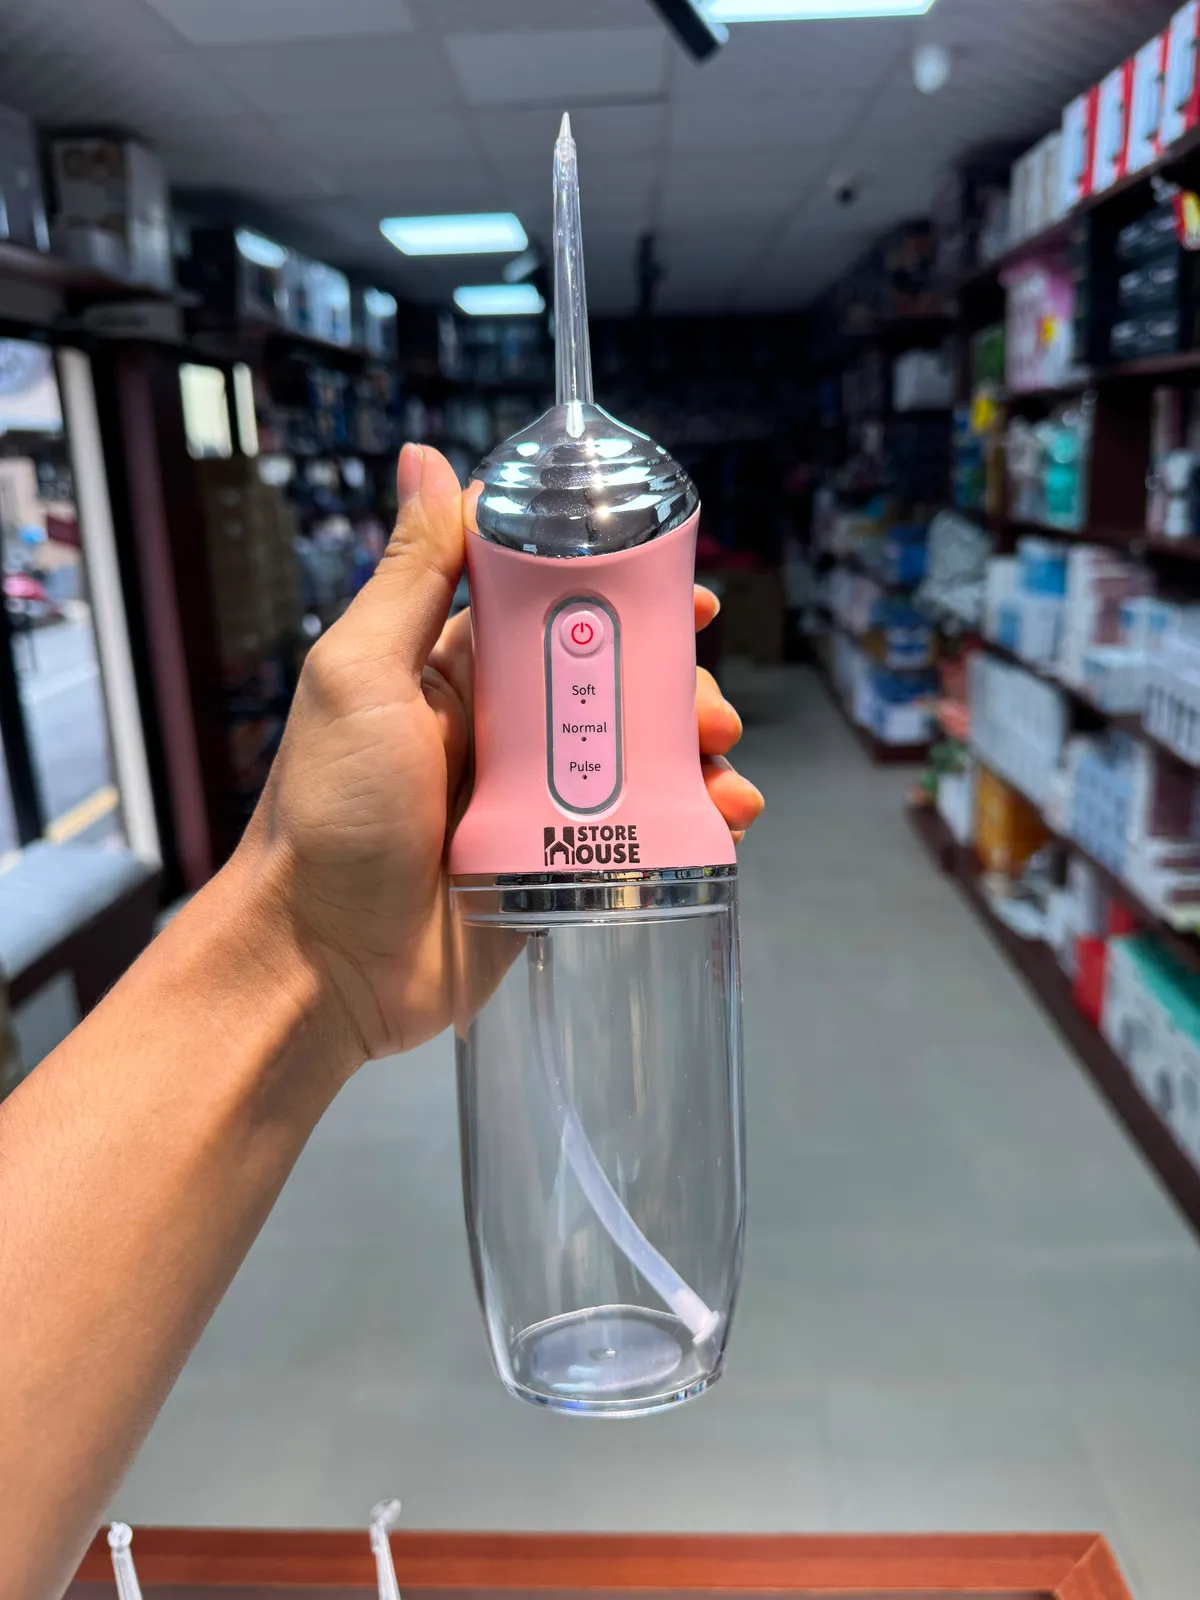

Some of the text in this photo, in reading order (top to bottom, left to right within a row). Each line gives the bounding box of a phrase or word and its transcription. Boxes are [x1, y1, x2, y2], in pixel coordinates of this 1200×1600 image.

[571, 684, 596, 696] Soft
[562, 721, 607, 734] Normal
[569, 760, 601, 772] Pulse
[577, 825, 637, 841] STORE
